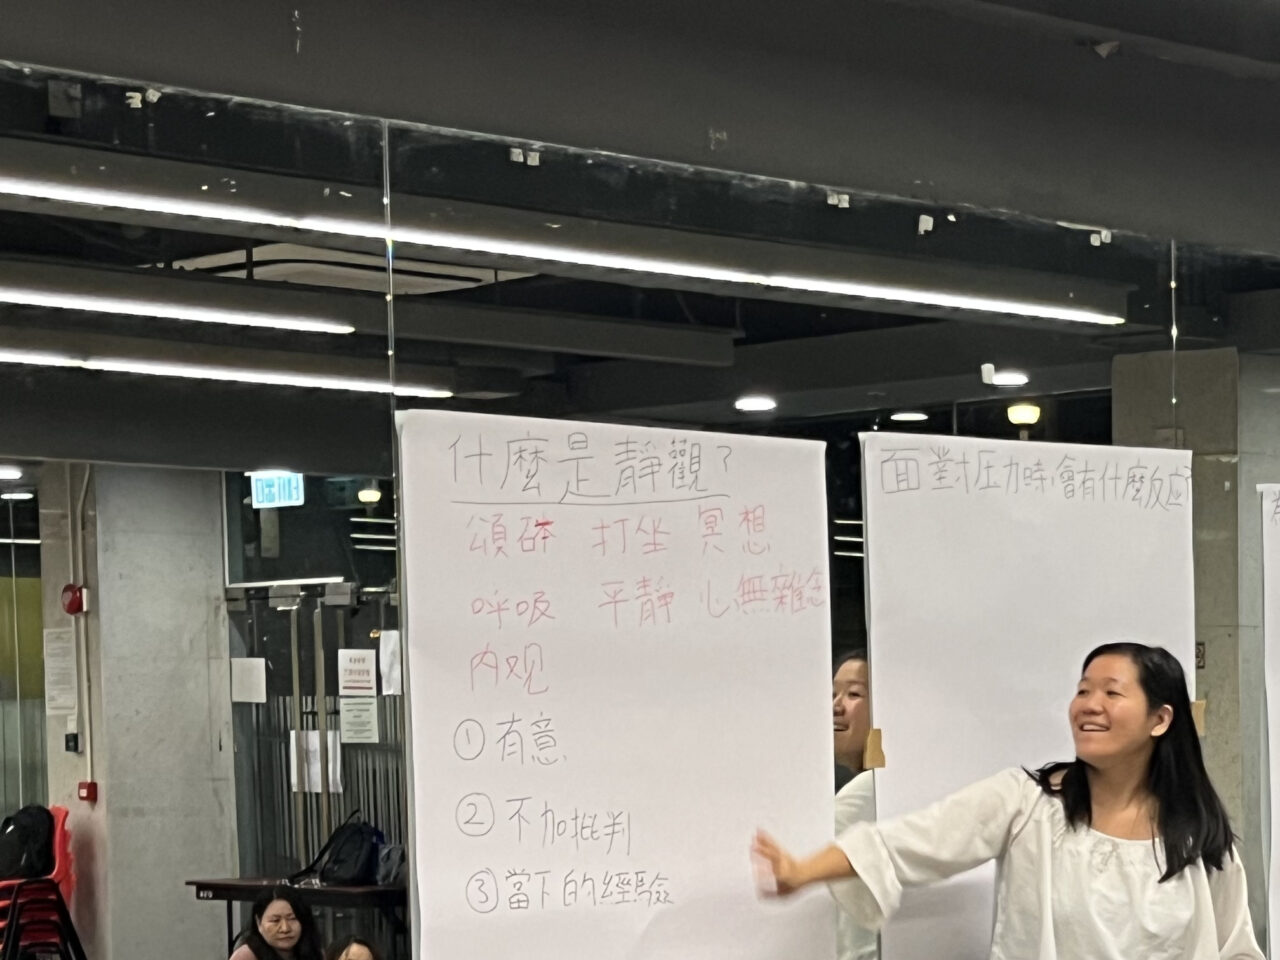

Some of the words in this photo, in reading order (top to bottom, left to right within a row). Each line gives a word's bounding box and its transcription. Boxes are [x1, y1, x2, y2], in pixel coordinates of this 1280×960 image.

[449, 431, 732, 502] 什麼是靜觀?
[591, 515, 671, 557] 打坐
[699, 504, 771, 556] 冥想
[471, 588, 556, 629] 呼吸
[598, 576, 675, 628] 平靜
